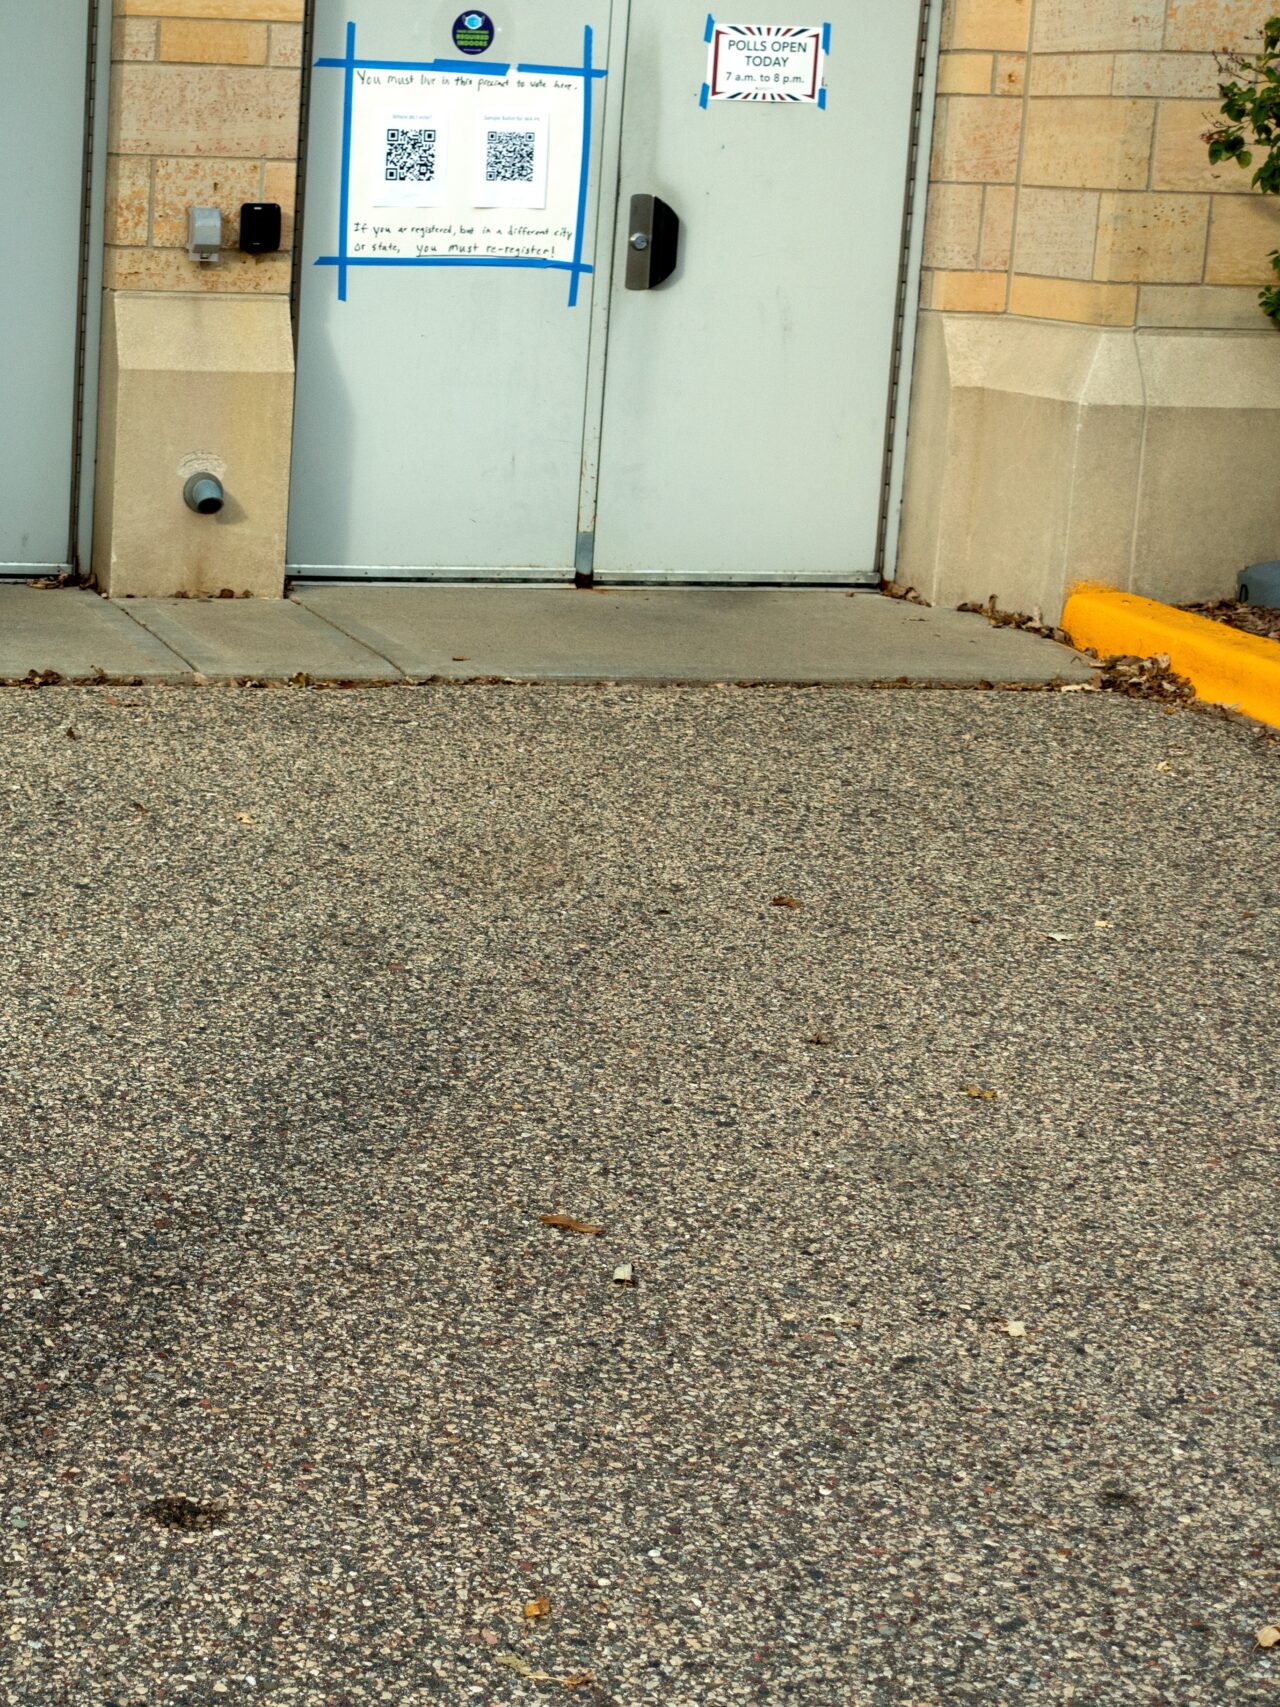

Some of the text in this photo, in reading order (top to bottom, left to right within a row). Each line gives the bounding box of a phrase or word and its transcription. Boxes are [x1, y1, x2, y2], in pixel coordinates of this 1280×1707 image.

[728, 40, 808, 53] POLLS OPEN
[745, 55, 789, 67] TODAY
[356, 70, 381, 85] You
[387, 75, 414, 85] must
[420, 74, 436, 85] live
[441, 76, 450, 85] in
[517, 79, 525, 88] to
[530, 80, 546, 88] vote
[726, 71, 804, 85] 7 a.m. to 8 p.m.
[354, 222, 368, 233] If
[373, 227, 391, 238] you
[411, 225, 456, 238] registered,
[460, 225, 474, 235] but
[482, 226, 491, 234] in
[508, 225, 549, 236] different
[553, 227, 573, 240] city
[354, 242, 555, 258] or state, you must re-register!
